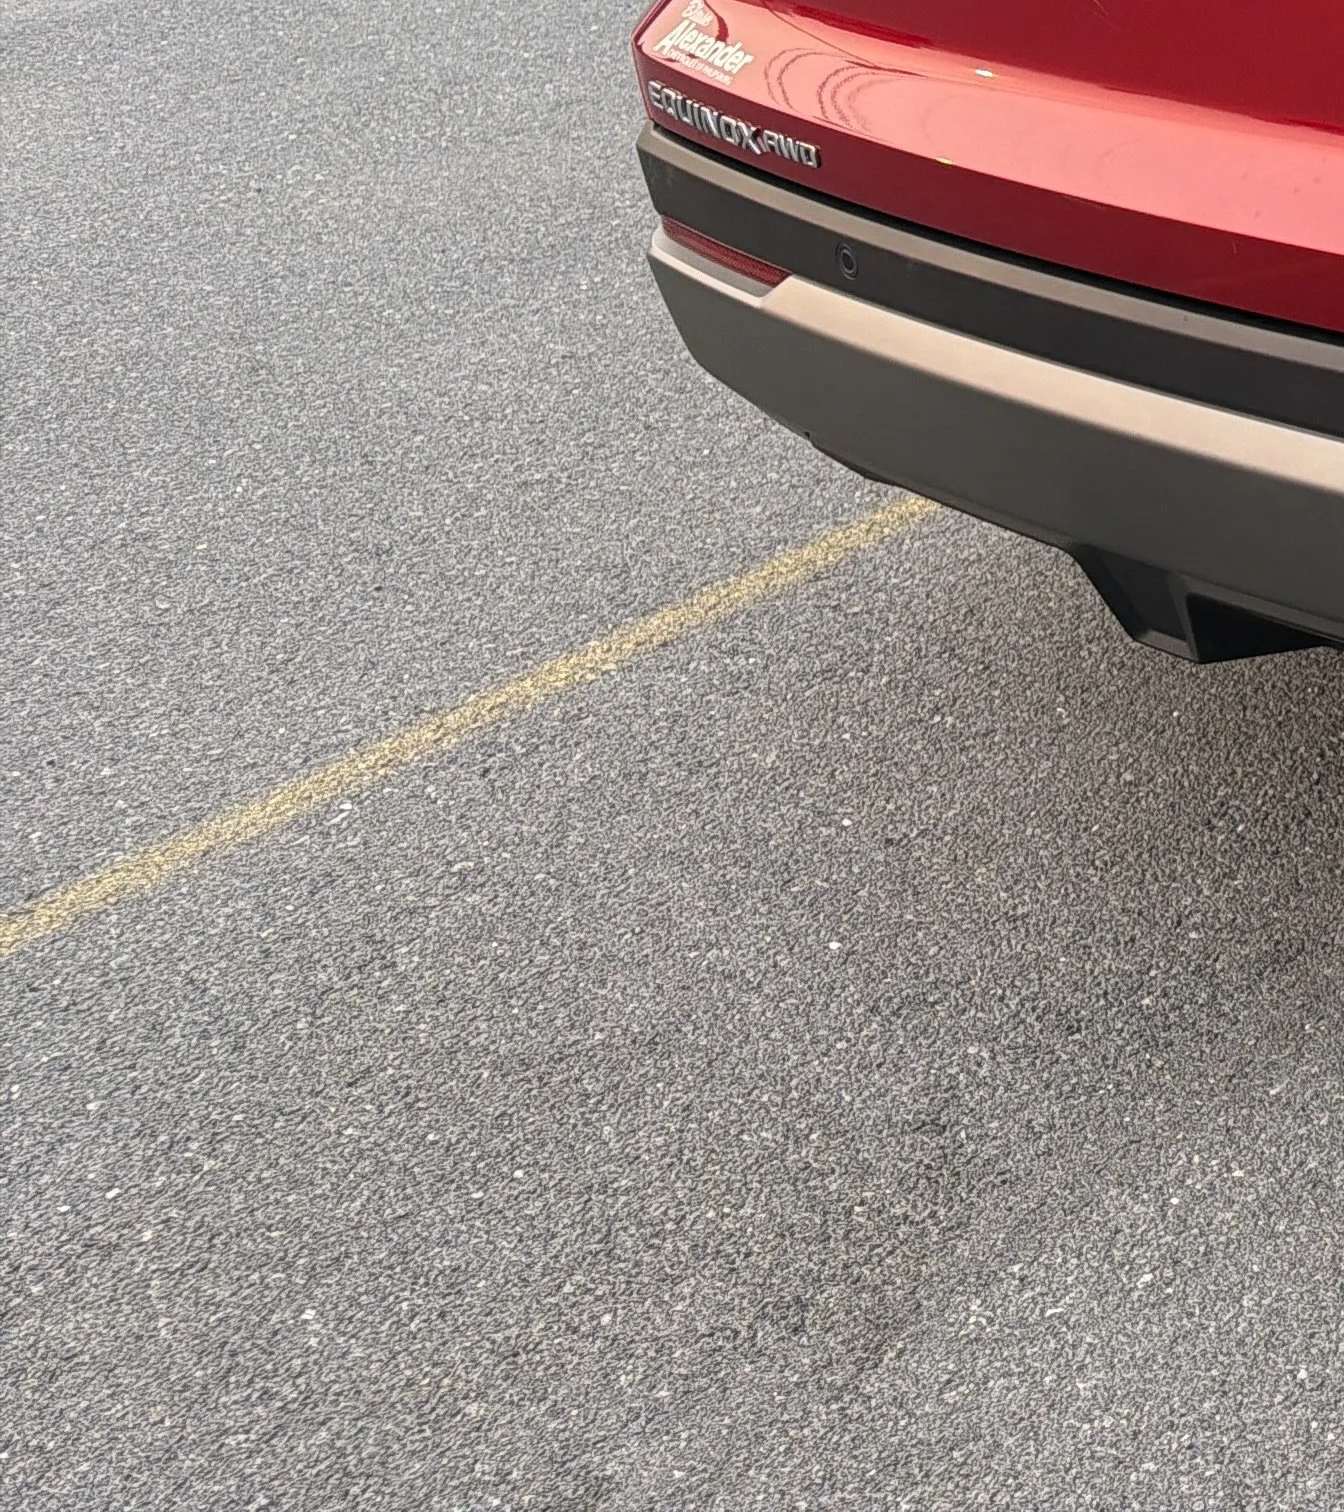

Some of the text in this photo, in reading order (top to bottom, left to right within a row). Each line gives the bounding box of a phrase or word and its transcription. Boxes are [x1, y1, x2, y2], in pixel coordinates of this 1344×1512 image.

[653, 19, 755, 74] Alexander
[648, 79, 821, 169] EQUINOX AWD
